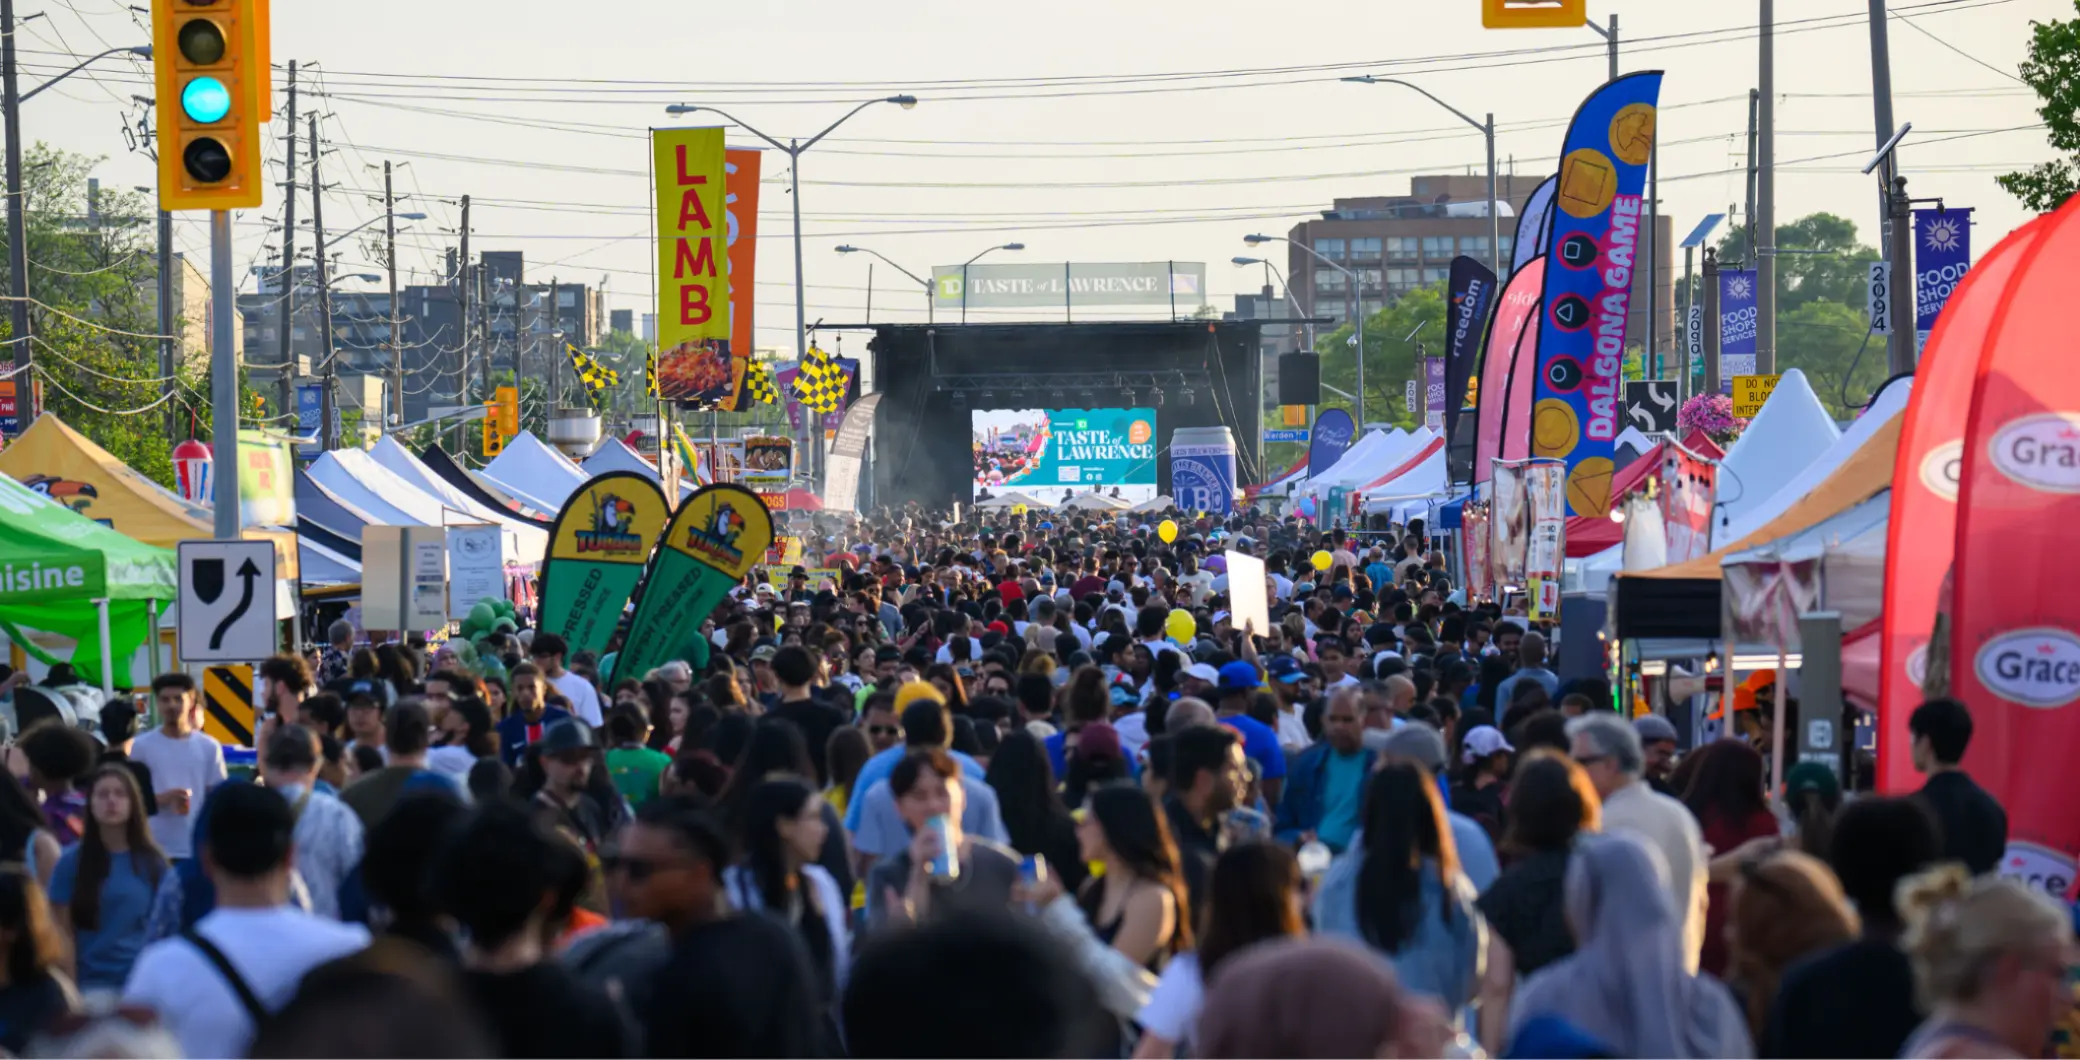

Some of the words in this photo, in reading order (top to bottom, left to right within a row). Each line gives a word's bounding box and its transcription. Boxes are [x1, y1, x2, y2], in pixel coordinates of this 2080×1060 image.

[674, 145, 717, 326] LAMB
[1606, 195, 1640, 289] GAME
[1917, 262, 1969, 288] FOOD
[942, 280, 962, 295] TD
[971, 278, 1034, 294] TASTE
[1037, 280, 1048, 292] of
[1051, 277, 1158, 294] LAWRENCE
[1873, 266, 1886, 331] 2094
[1721, 307, 1757, 325] FOOD
[1691, 308, 1700, 354] 2090
[1722, 319, 1757, 336] SHOPS
[1722, 330, 1757, 345] SERVICES
[1589, 293, 1627, 439] DALGONA
[1428, 383, 1445, 393] FOO
[1746, 379, 1757, 389] DO
[1764, 379, 1779, 388] NO
[1054, 430, 1110, 445] TASTE
[1058, 444, 1153, 460] LAWRENCE
[562, 568, 602, 642] PRESSED
[1995, 651, 2080, 685] Grace
